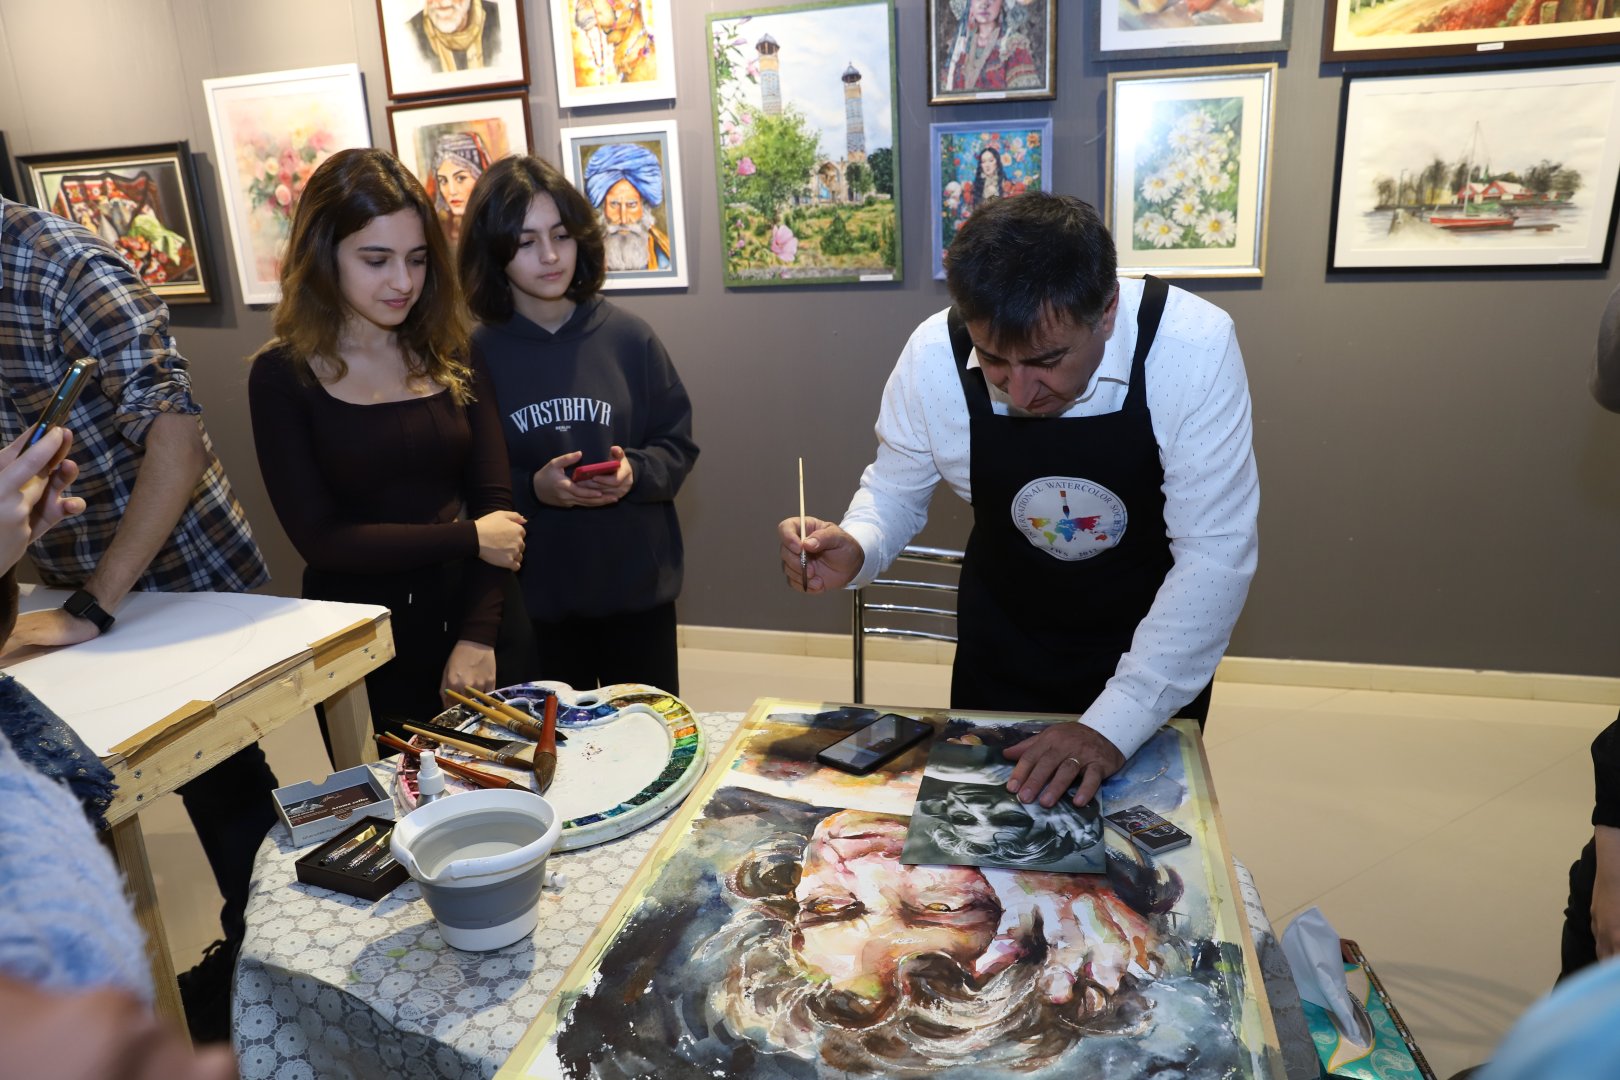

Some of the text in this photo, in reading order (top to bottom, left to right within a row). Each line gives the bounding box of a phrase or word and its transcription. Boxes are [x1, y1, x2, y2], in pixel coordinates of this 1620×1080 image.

[509, 397, 612, 434] WRSTBHVR
[1015, 481, 1124, 540] INTERNATIONAL WATERCOLOR SOCIETY
